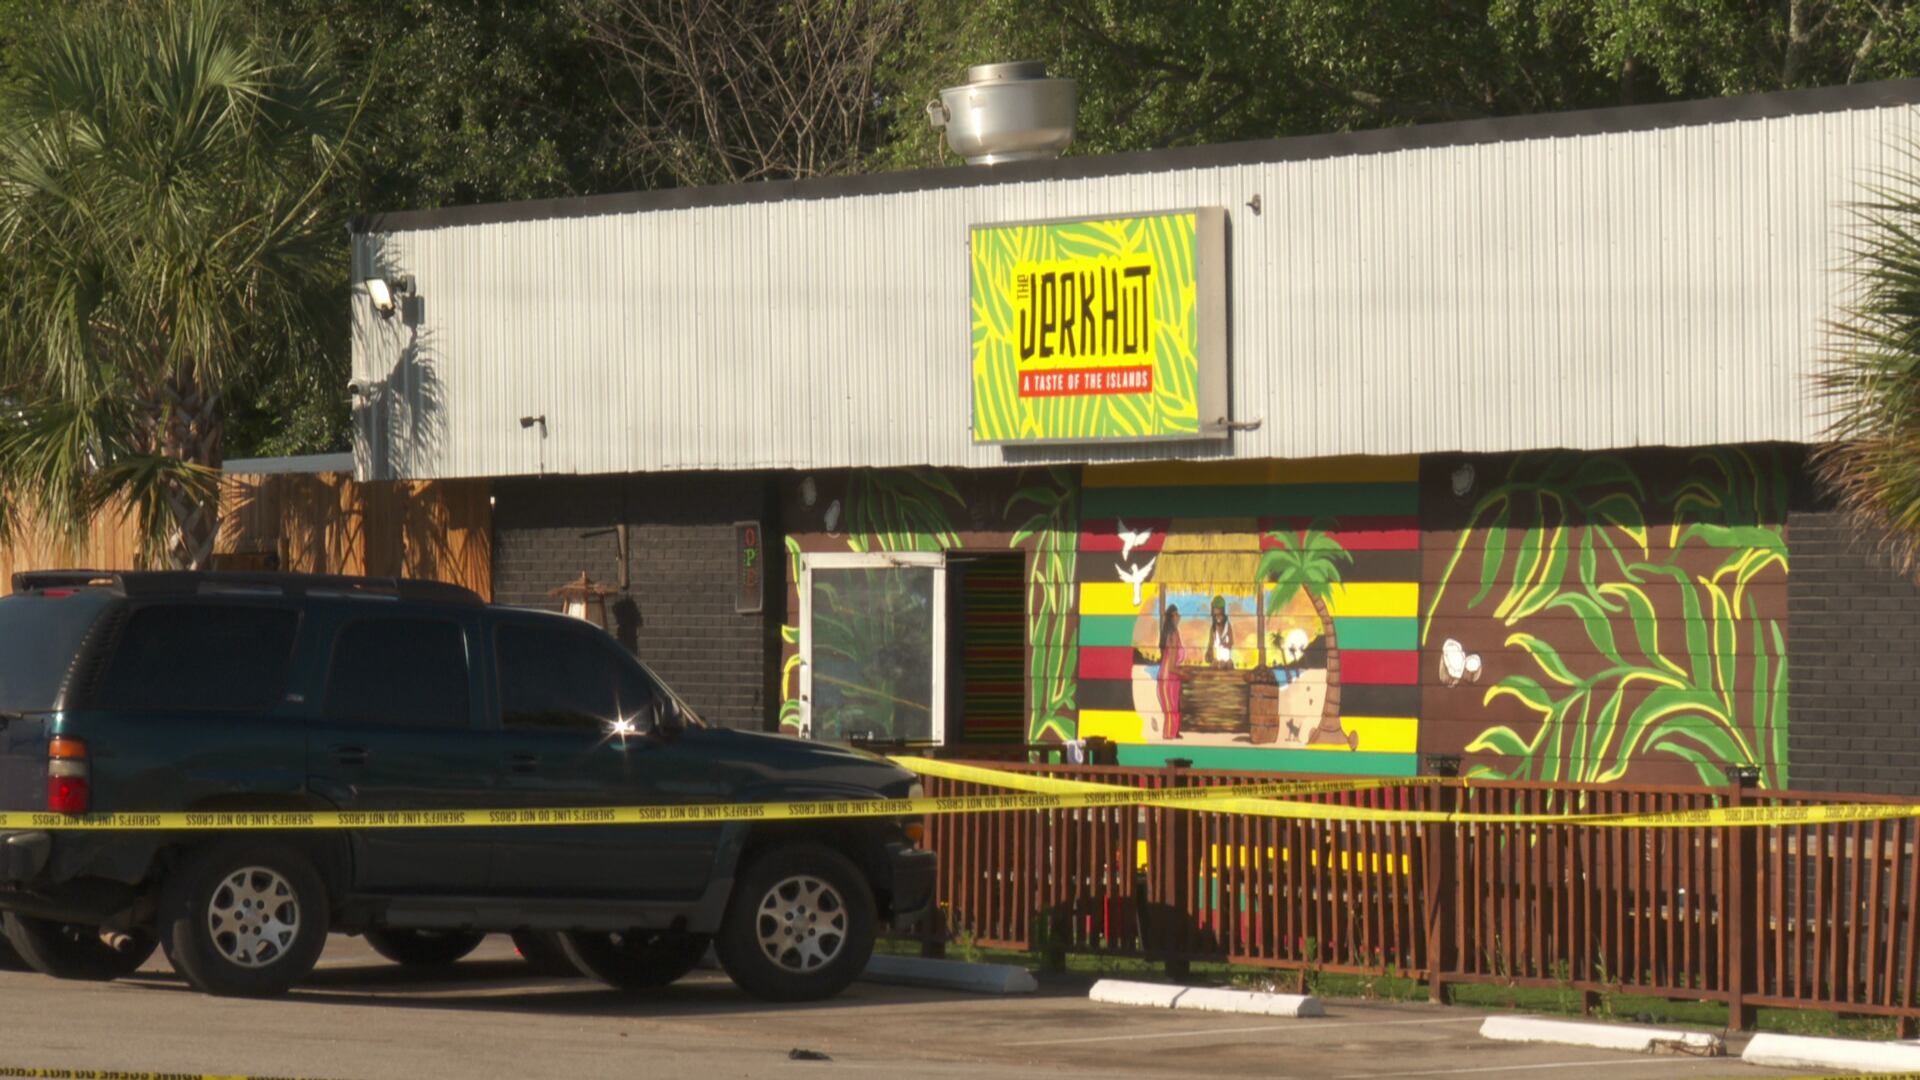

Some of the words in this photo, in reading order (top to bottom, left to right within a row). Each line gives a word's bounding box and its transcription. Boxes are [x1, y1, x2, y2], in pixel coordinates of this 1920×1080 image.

[1017, 274, 1029, 299] THE
[1024, 377, 1030, 391] A
[1034, 375, 1064, 391] TASTE
[1068, 374, 1080, 390] OF
[1085, 372, 1102, 389] THE
[1106, 371, 1149, 389] ISLANDS
[837, 803, 848, 814] DO
[852, 802, 870, 813] LINE
[872, 801, 913, 812] SHERIFF'S
[936, 800, 964, 810] CROSS
[966, 800, 981, 809] NOT
[984, 799, 996, 808] DO
[1000, 798, 1018, 808] LINE
[639, 808, 666, 819] CROSS
[670, 808, 685, 818] NOT
[688, 807, 700, 818] DO
[703, 806, 720, 818] LINE
[724, 806, 764, 817] SHERIFF'S
[788, 804, 816, 815] CROSS
[818, 804, 834, 814] NOT
[32, 815, 61, 826] CROSS
[120, 814, 161, 826] SHERIFF'S
[186, 814, 214, 825] CROSS
[216, 814, 233, 825] NOT
[236, 814, 248, 825] DO
[251, 814, 270, 825] LINE
[272, 814, 314, 825] SHERIFF'S
[338, 813, 366, 825] CROSS
[369, 812, 385, 824] NOT
[388, 812, 399, 824] DO
[402, 812, 421, 824] LINE
[424, 812, 465, 823] SHERIFF'S
[489, 811, 517, 822] CROSS
[520, 811, 536, 822] NOT
[538, 810, 550, 822] DO
[553, 810, 572, 821] LINE
[574, 809, 615, 821] SHERIFF'S
